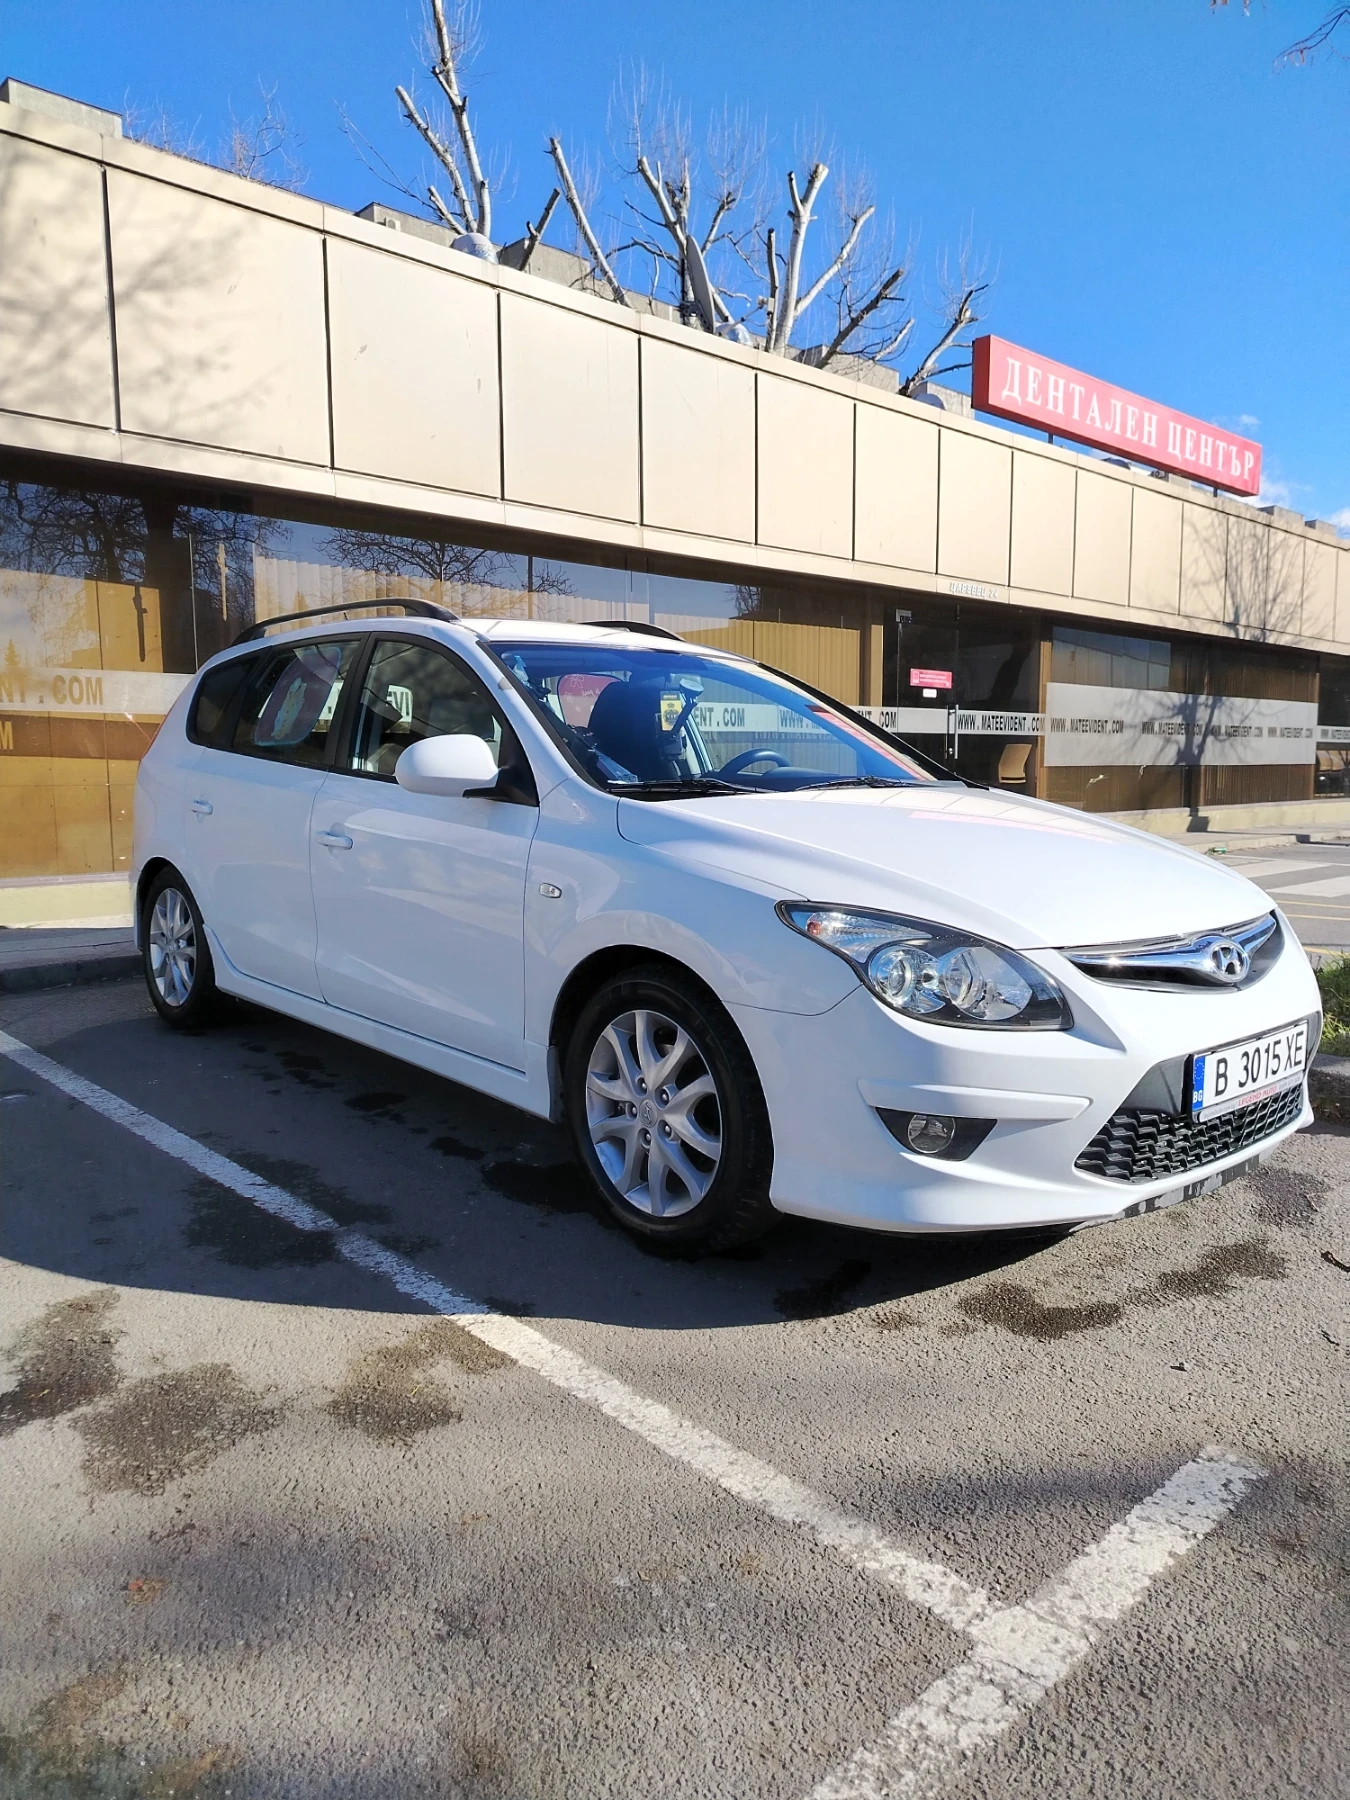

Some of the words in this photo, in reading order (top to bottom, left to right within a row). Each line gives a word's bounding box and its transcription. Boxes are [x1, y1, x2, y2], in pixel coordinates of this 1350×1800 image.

[1001, 357, 1158, 447] ДЕНТАЛЕН
[1167, 421, 1254, 481] ЦЕНТЪР
[1192, 1089, 1203, 1104] BG
[1214, 1057, 1228, 1097] B
[1238, 1039, 1281, 1088] 3015
[1284, 1030, 1304, 1072] XE
